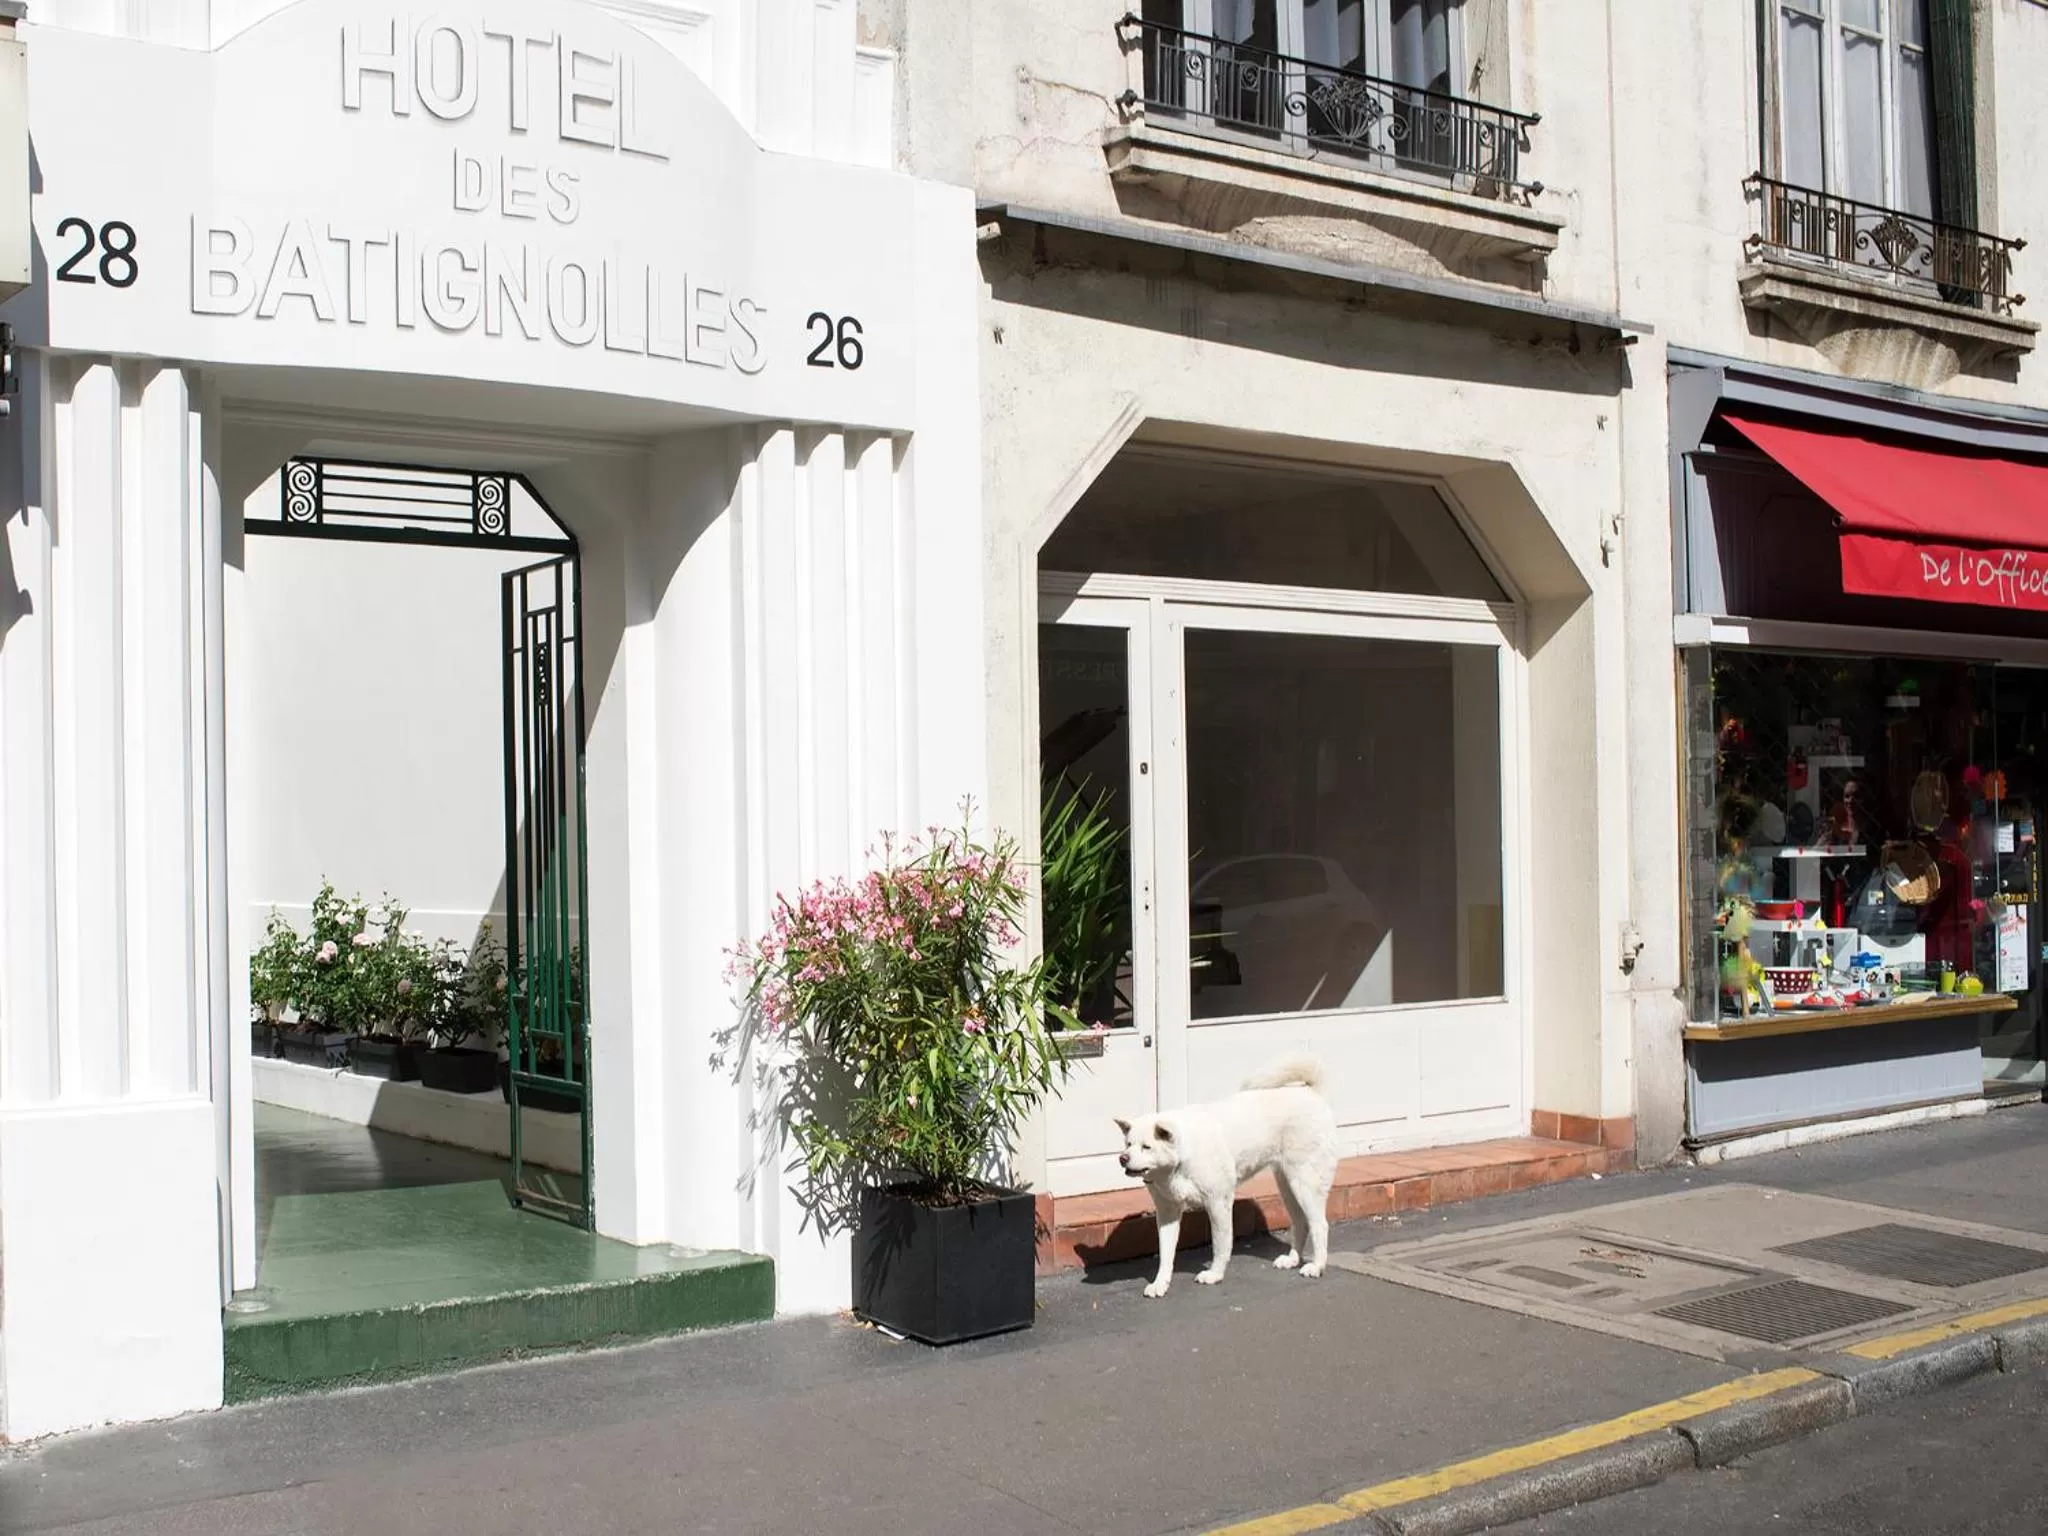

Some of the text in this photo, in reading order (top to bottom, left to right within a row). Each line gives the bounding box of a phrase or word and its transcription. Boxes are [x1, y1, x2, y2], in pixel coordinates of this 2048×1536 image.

[341, 12, 669, 161] HOTEL
[453, 146, 580, 223] DES
[56, 217, 139, 288] 28
[191, 211, 768, 376] BATIGNOLLES
[806, 311, 864, 370] 26
[1920, 551, 1951, 586] De
